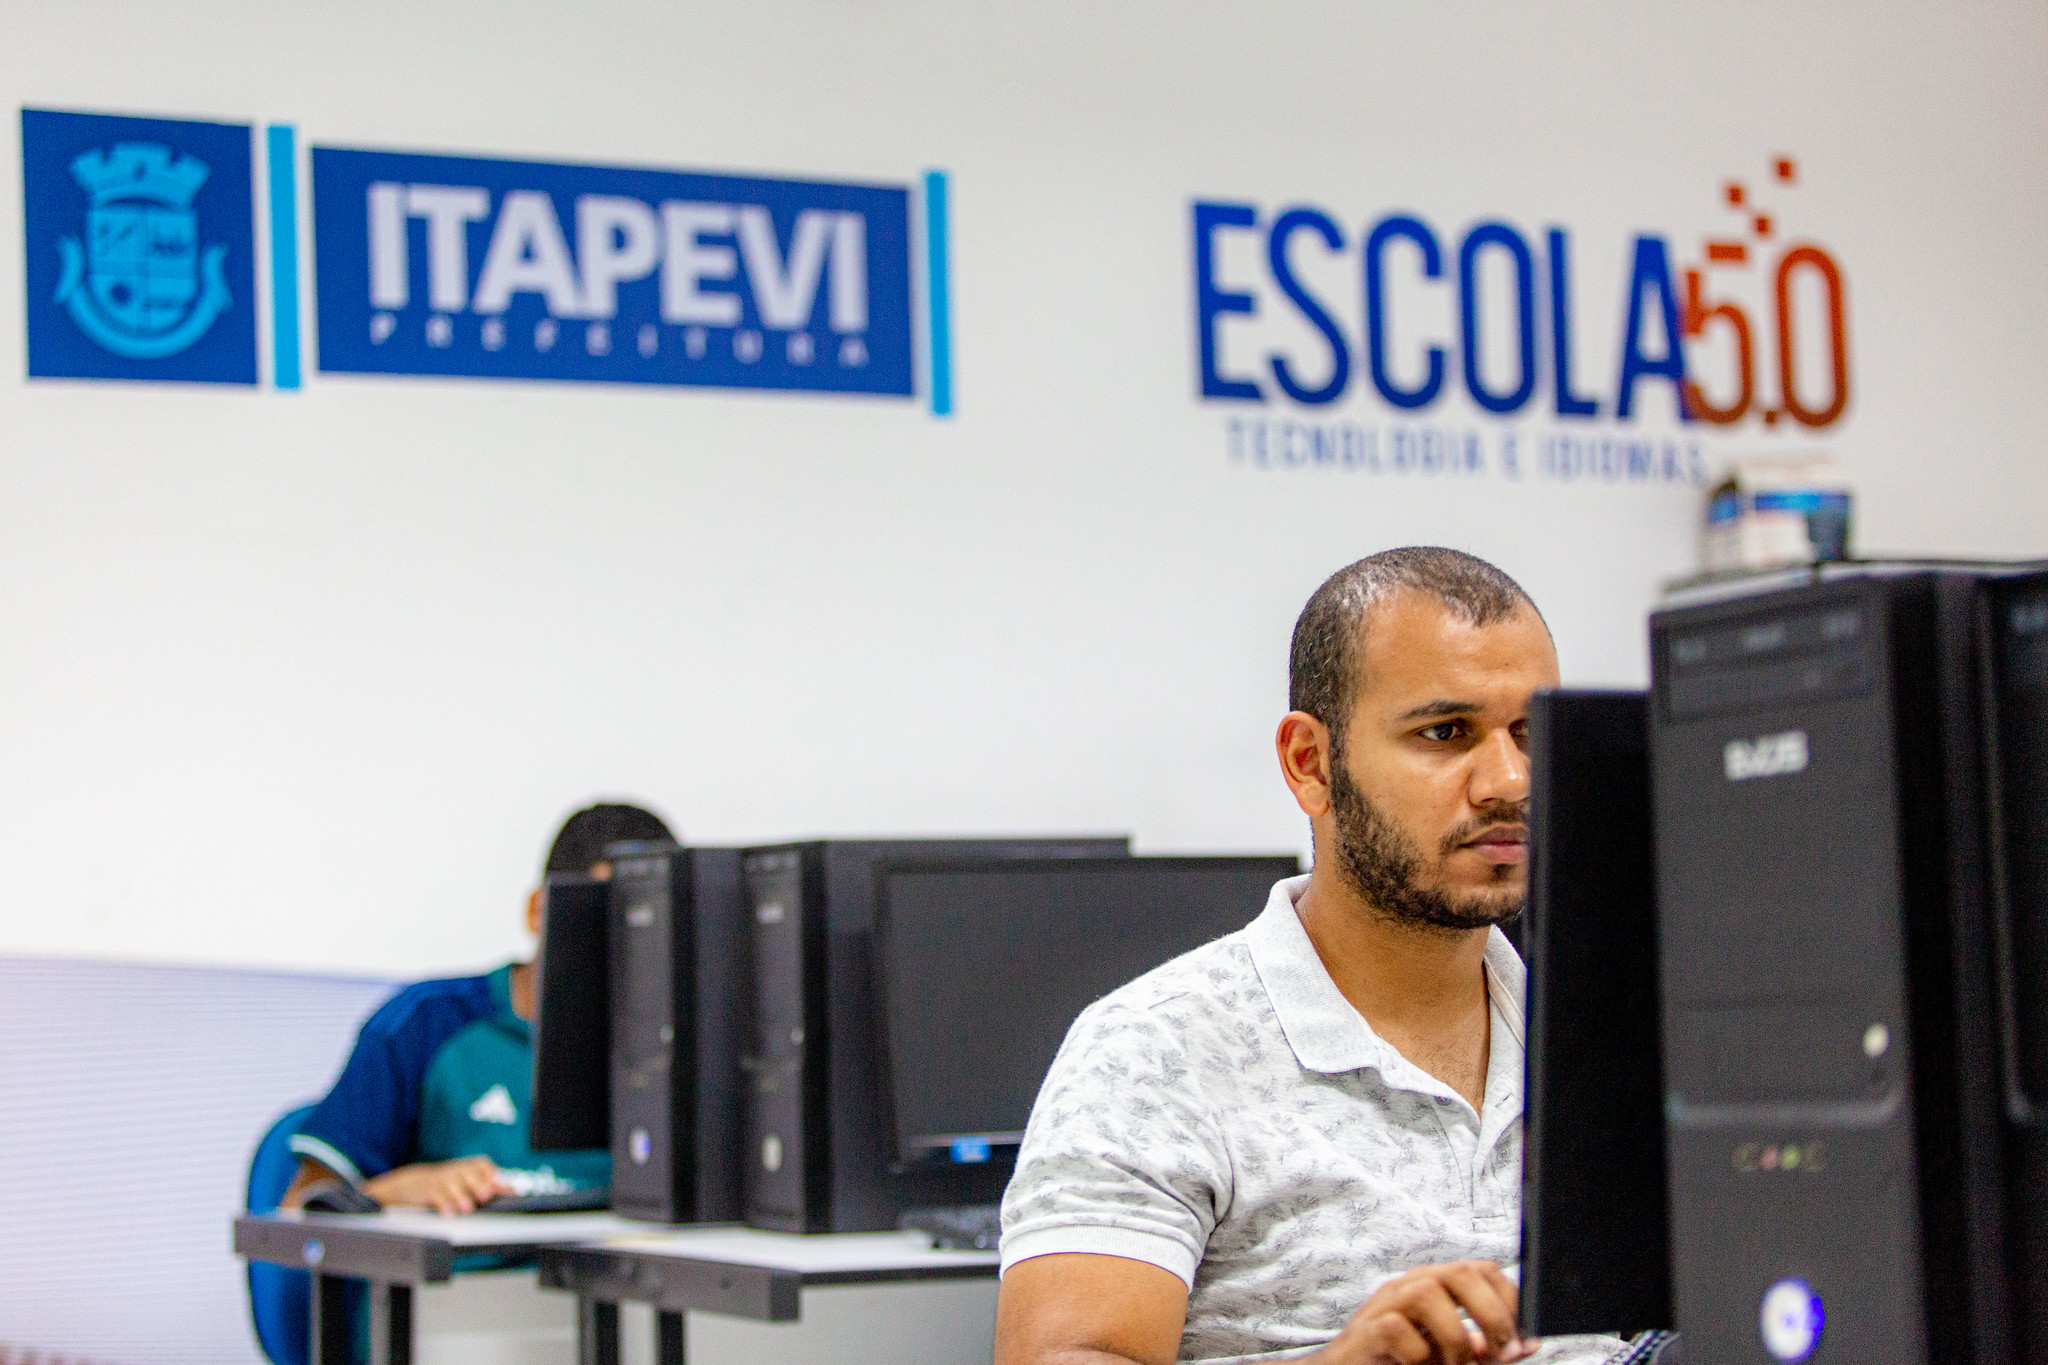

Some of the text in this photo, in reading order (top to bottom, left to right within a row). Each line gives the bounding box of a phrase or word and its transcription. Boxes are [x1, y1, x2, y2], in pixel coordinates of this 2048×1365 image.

[367, 181, 868, 332] ITAPEVI
[1190, 199, 1849, 429] ESCOLA 5.0
